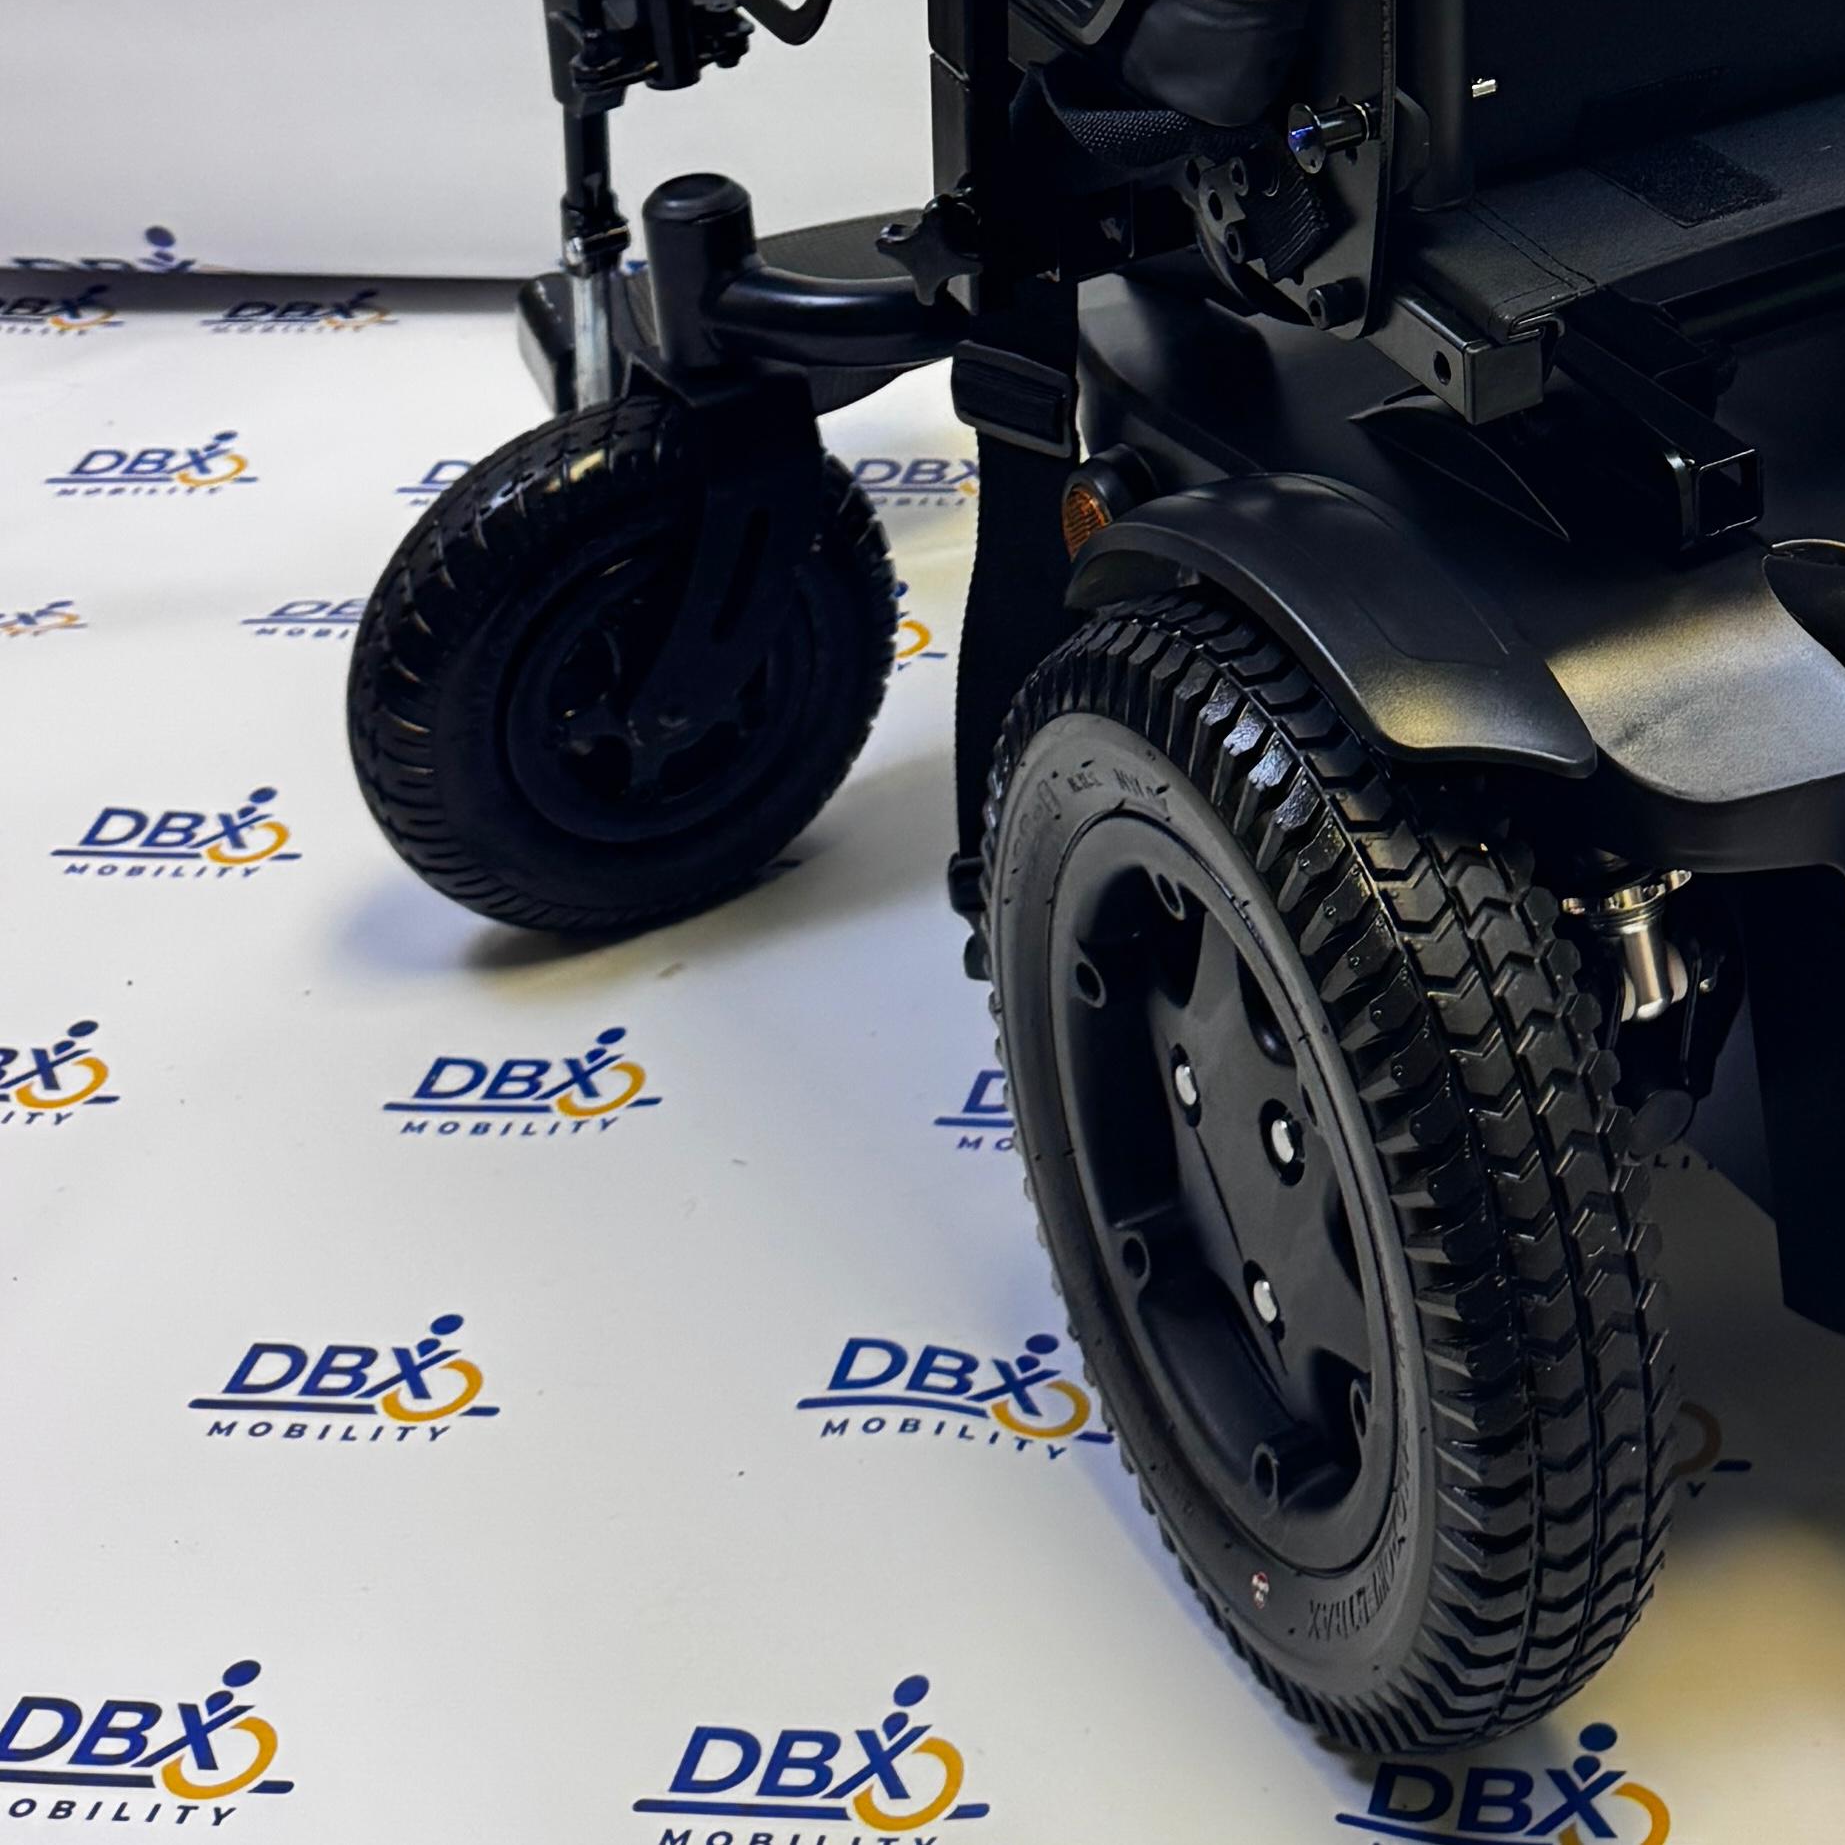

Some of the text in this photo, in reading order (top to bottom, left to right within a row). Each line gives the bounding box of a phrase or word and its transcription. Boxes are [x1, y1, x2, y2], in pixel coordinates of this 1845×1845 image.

[70, 448, 232, 475] DBX
[80, 807, 275, 849] DBX
[64, 862, 260, 880] MOBILITY
[413, 1058, 623, 1101] DBX
[401, 1116, 617, 1136] MOBILITY
[223, 1341, 459, 1402] DBX
[827, 1337, 1061, 1416] DBX
[207, 1419, 453, 1443] MOBILITY
[822, 1415, 1066, 1460] MOBILITY
[0, 1696, 255, 1770] DBX
[669, 1724, 932, 1800] DBX
[8, 1798, 236, 1826] OBILITY
[1367, 1763, 1626, 1838] DBX
